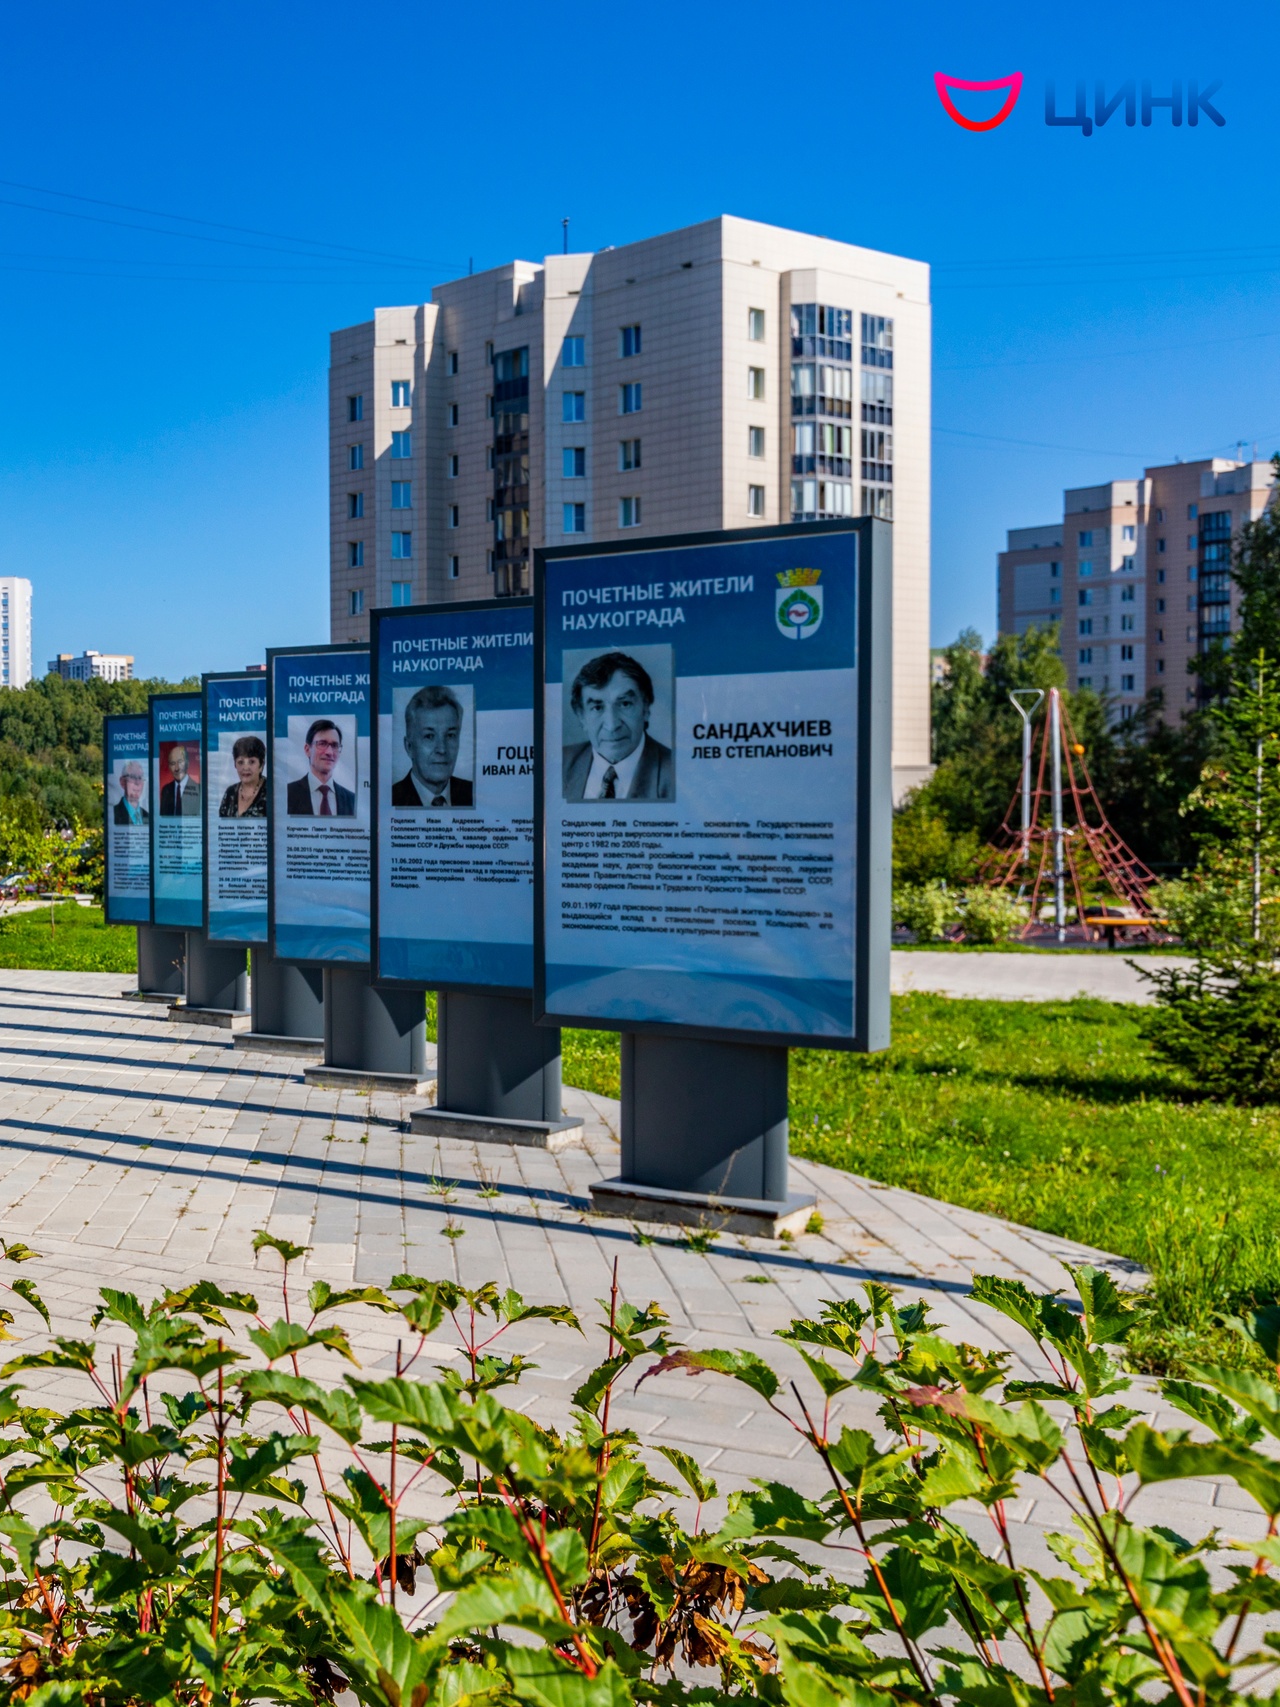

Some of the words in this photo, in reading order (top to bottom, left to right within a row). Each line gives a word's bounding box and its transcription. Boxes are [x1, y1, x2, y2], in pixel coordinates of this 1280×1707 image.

[562, 583, 664, 606] ПОЧЕТНЫЕ
[669, 575, 754, 599] ЖИТЕЛИ
[562, 607, 685, 631] НАУКОГРАДА
[392, 636, 468, 653] ПОЧЕТНЫЕ
[472, 632, 533, 648] ЖИТЕЛИ
[392, 656, 484, 673] НАУКОГРАДА
[289, 674, 352, 687] ПОЧЕТНЫЕ
[219, 697, 266, 708] ПОЧЕТНЫ
[289, 691, 365, 704] НАУКОГРАДА
[159, 710, 198, 720] ПОЧЕТНЫЕ
[219, 711, 266, 722] НАУКОГР
[159, 722, 202, 732] НАУКОГРАД
[693, 720, 832, 742] САНДАХЧИЕВ
[113, 732, 147, 740] ПОЧЕТНЫЕ
[113, 743, 149, 751] НАУКОГРАД
[691, 746, 722, 760] ЛЕВ
[725, 744, 833, 759] СТЕПАНОВИЧ
[497, 746, 534, 761] ГОЦЕ
[482, 764, 515, 776] ИВАН
[561, 820, 606, 828] Сандахчиев
[633, 820, 678, 828] Степанович
[756, 820, 834, 830] Государственного
[591, 840, 609, 848] 1982
[621, 840, 640, 848] 2005
[561, 851, 599, 859] Всемирно
[648, 852, 694, 860] российский
[594, 871, 651, 880] Правительства
[662, 883, 703, 892] Трудового
[704, 885, 742, 893] Красного
[561, 901, 602, 909] 09.01.1997
[603, 903, 620, 911] года
[622, 903, 663, 912] присвоено
[740, 908, 773, 916] житель
[620, 915, 644, 923] вклад
[819, 922, 834, 930] его
